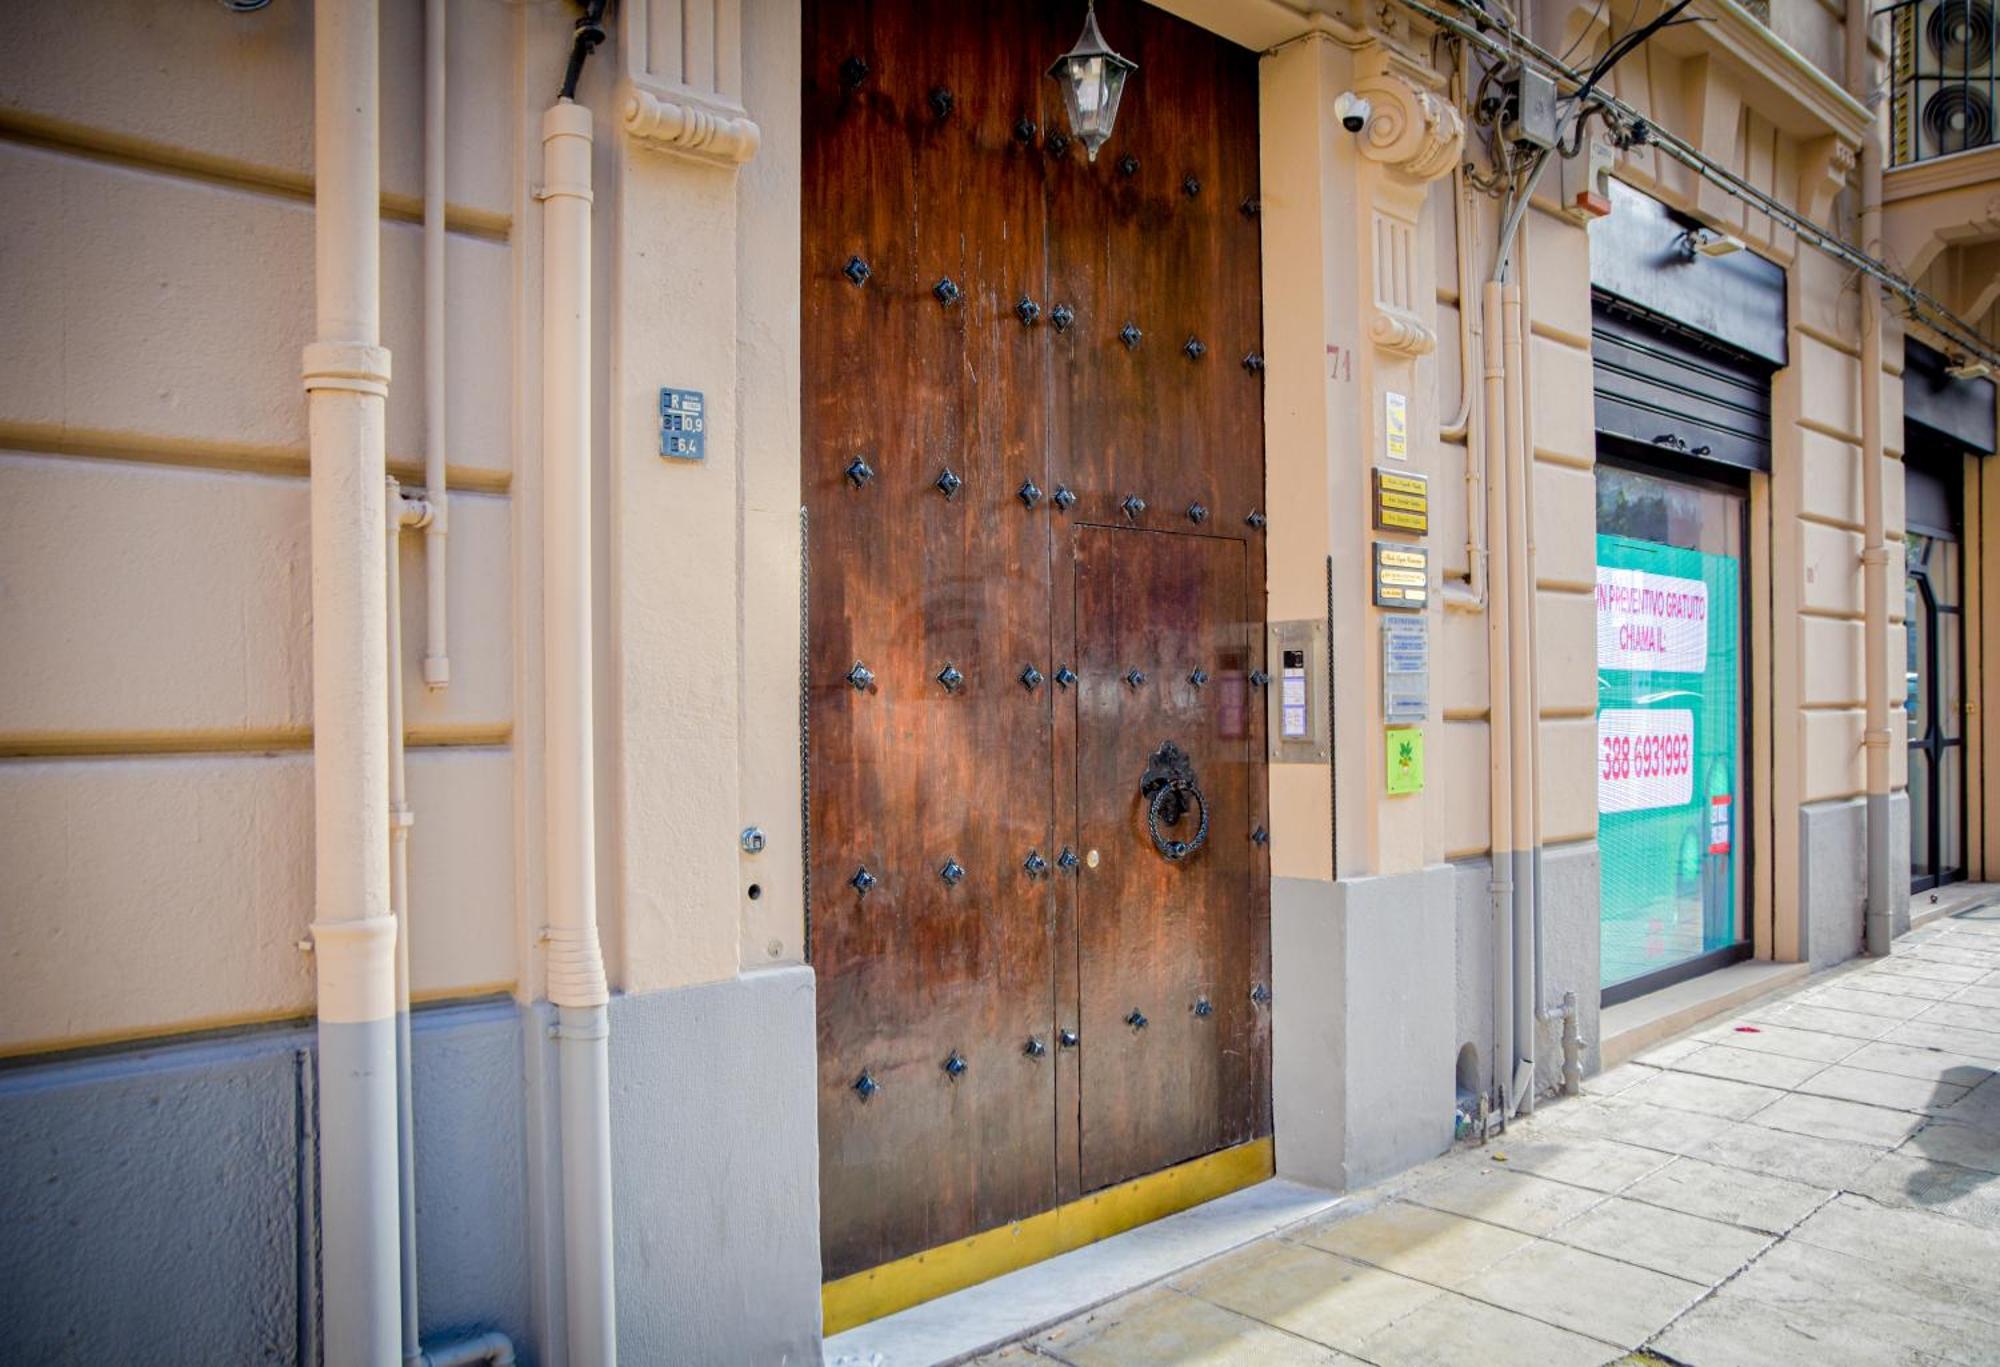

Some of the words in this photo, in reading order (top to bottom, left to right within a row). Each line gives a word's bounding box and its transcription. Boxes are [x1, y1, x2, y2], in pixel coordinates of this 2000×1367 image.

[1326, 344, 1351, 382] 71
[671, 394, 679, 409] R
[1608, 585, 1664, 617] PREVENTIVO
[1666, 592, 1705, 620] GRATUITO
[1619, 624, 1655, 651] CHIAMA
[1603, 735, 1631, 781] 388
[1633, 733, 1689, 778] 6931993
